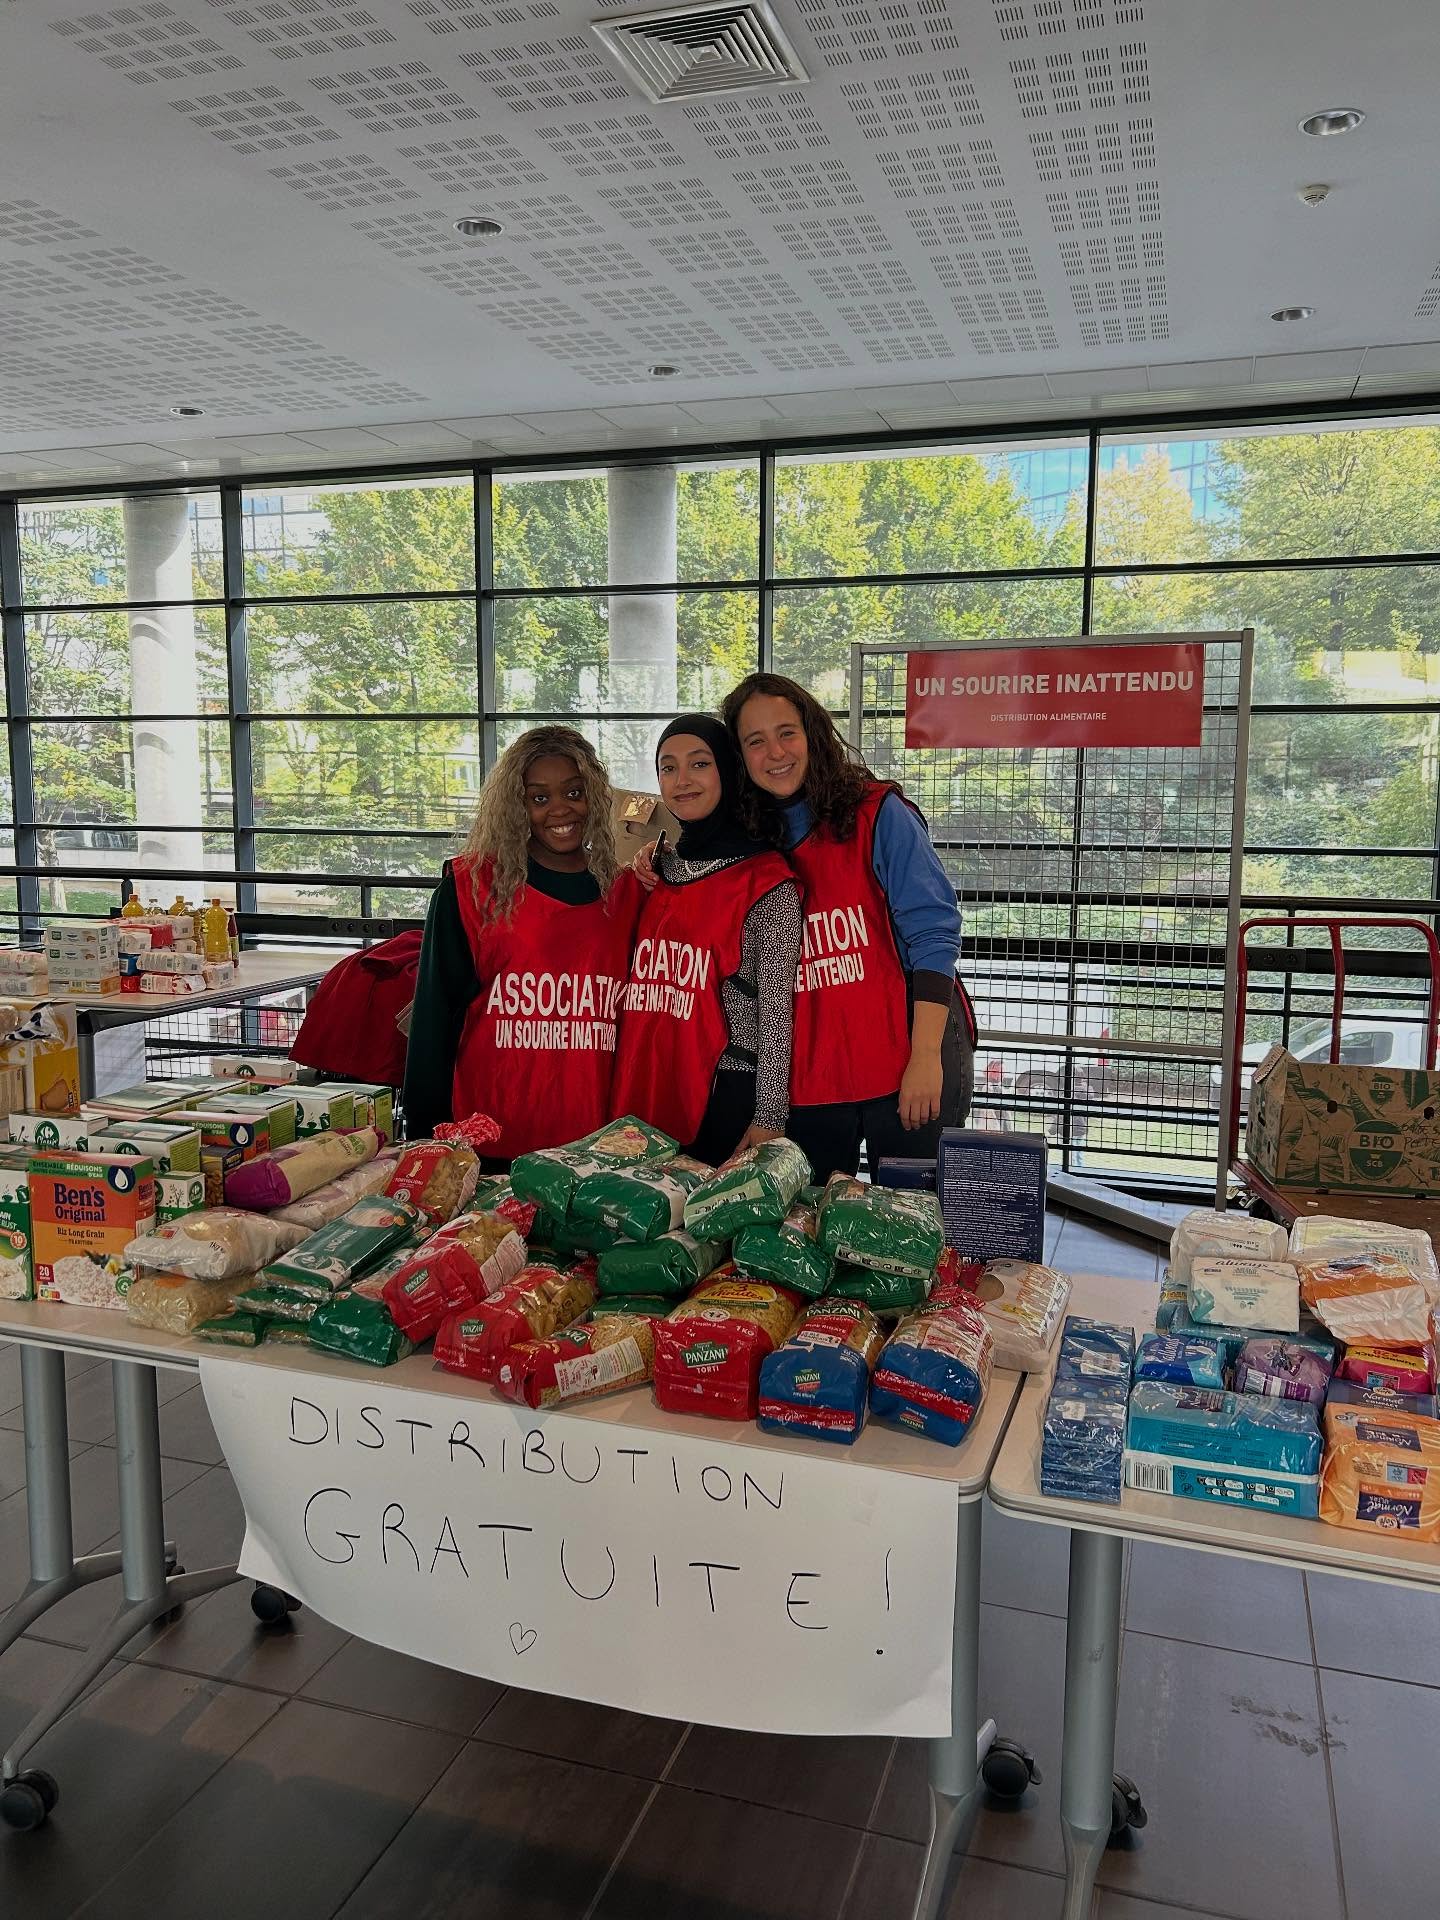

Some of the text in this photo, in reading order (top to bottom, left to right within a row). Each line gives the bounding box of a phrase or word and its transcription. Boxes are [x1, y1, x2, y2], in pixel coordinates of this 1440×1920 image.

[915, 671, 1194, 696] UN SOURIRE INATTENDU
[990, 712, 1107, 722] DISTRIBUTION ALIMENTAIRE
[495, 1019, 513, 1048] UN
[514, 1019, 569, 1049] SOURIRE
[1360, 1134, 1395, 1149] BIO
[66, 1162, 103, 1173] RÉDUISONS
[54, 1183, 105, 1208] Ben's
[55, 1205, 105, 1223] Original
[68, 1228, 85, 1238] Long
[86, 1230, 105, 1239] Grain
[39, 1265, 50, 1277] 20
[1215, 1260, 1270, 1269] always
[806, 1306, 861, 1319] PANZANI
[685, 1348, 727, 1365] PANZANI
[696, 1365, 720, 1374] TORTI
[795, 1373, 821, 1384] PANZANI
[1362, 1392, 1404, 1405] Normal
[288, 1396, 784, 1510] DISTRIBUTION
[1366, 1501, 1413, 1517] Normal
[304, 1487, 892, 1655] GRATUITE !
